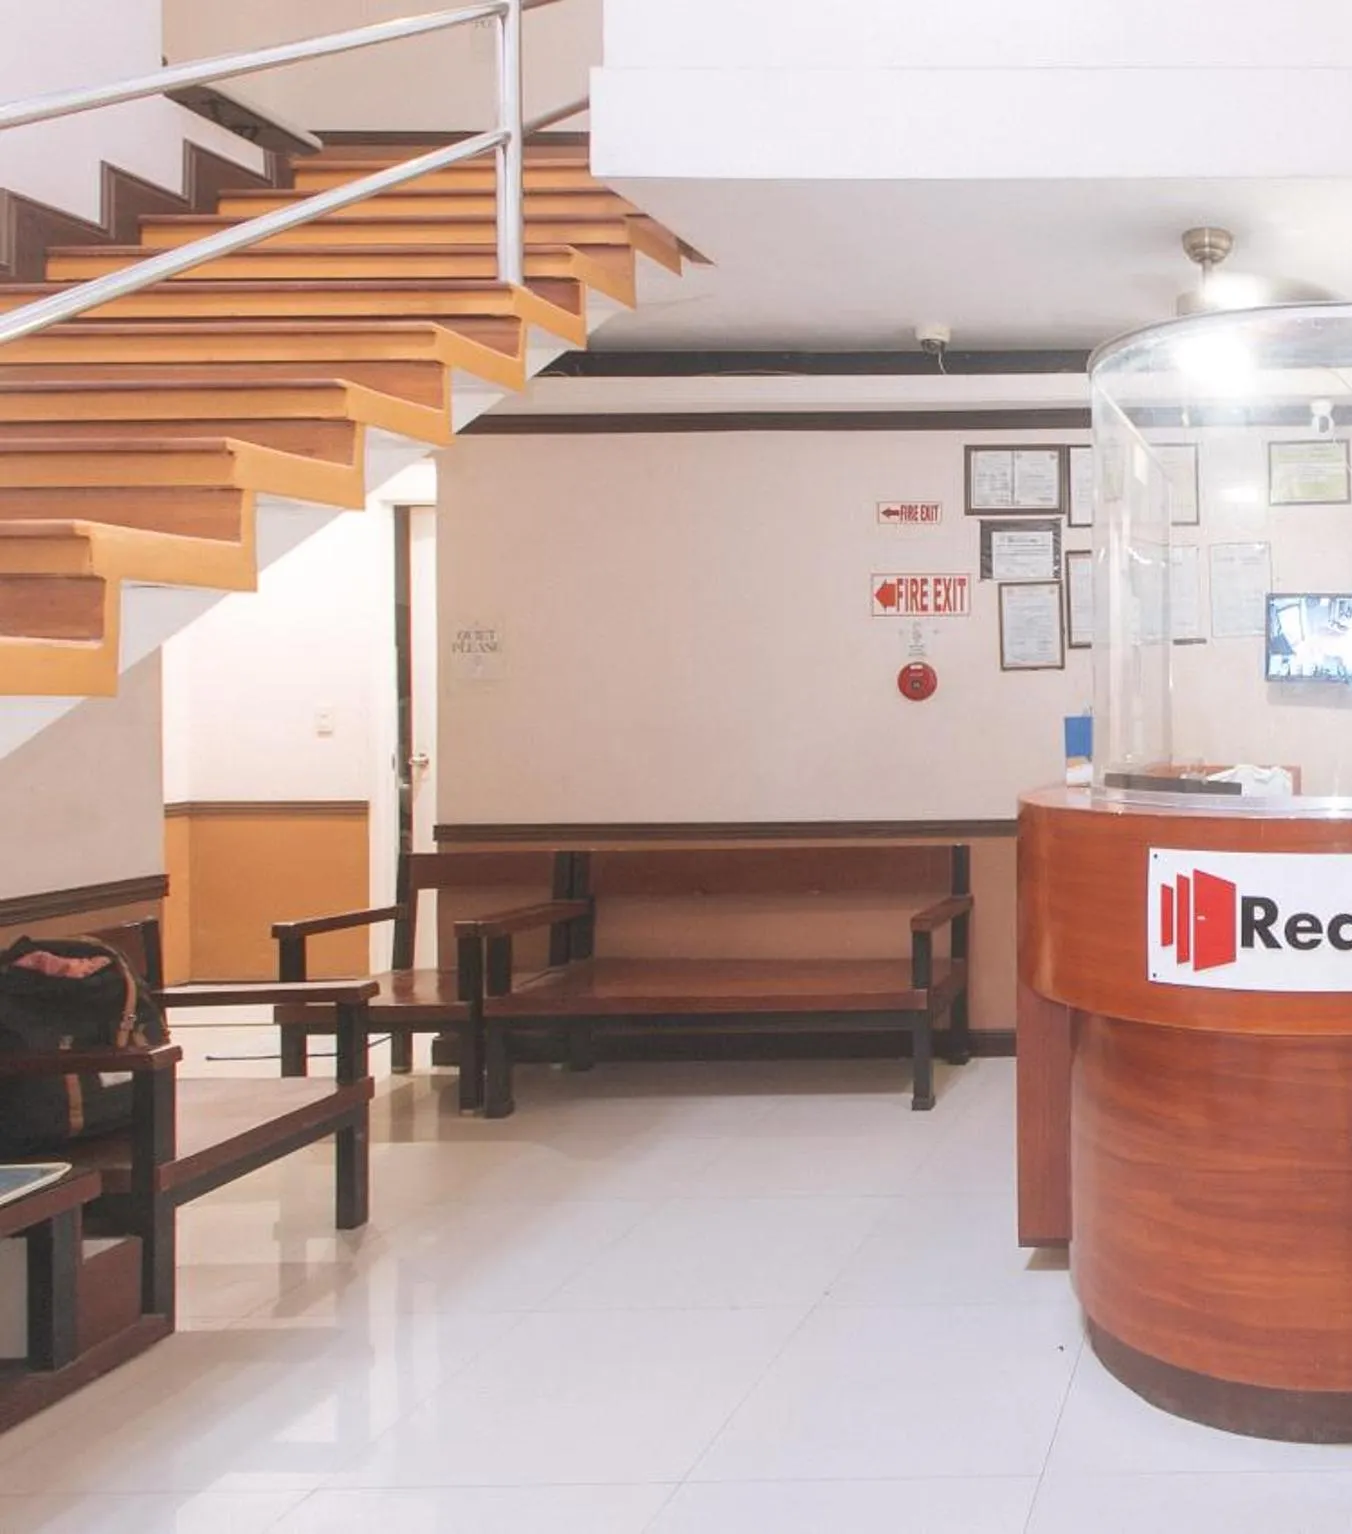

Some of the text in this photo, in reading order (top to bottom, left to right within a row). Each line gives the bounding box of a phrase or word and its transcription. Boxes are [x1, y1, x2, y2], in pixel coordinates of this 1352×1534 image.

[900, 503, 938, 521] FIRE EXIT
[896, 578, 967, 612] FIRE EXIT
